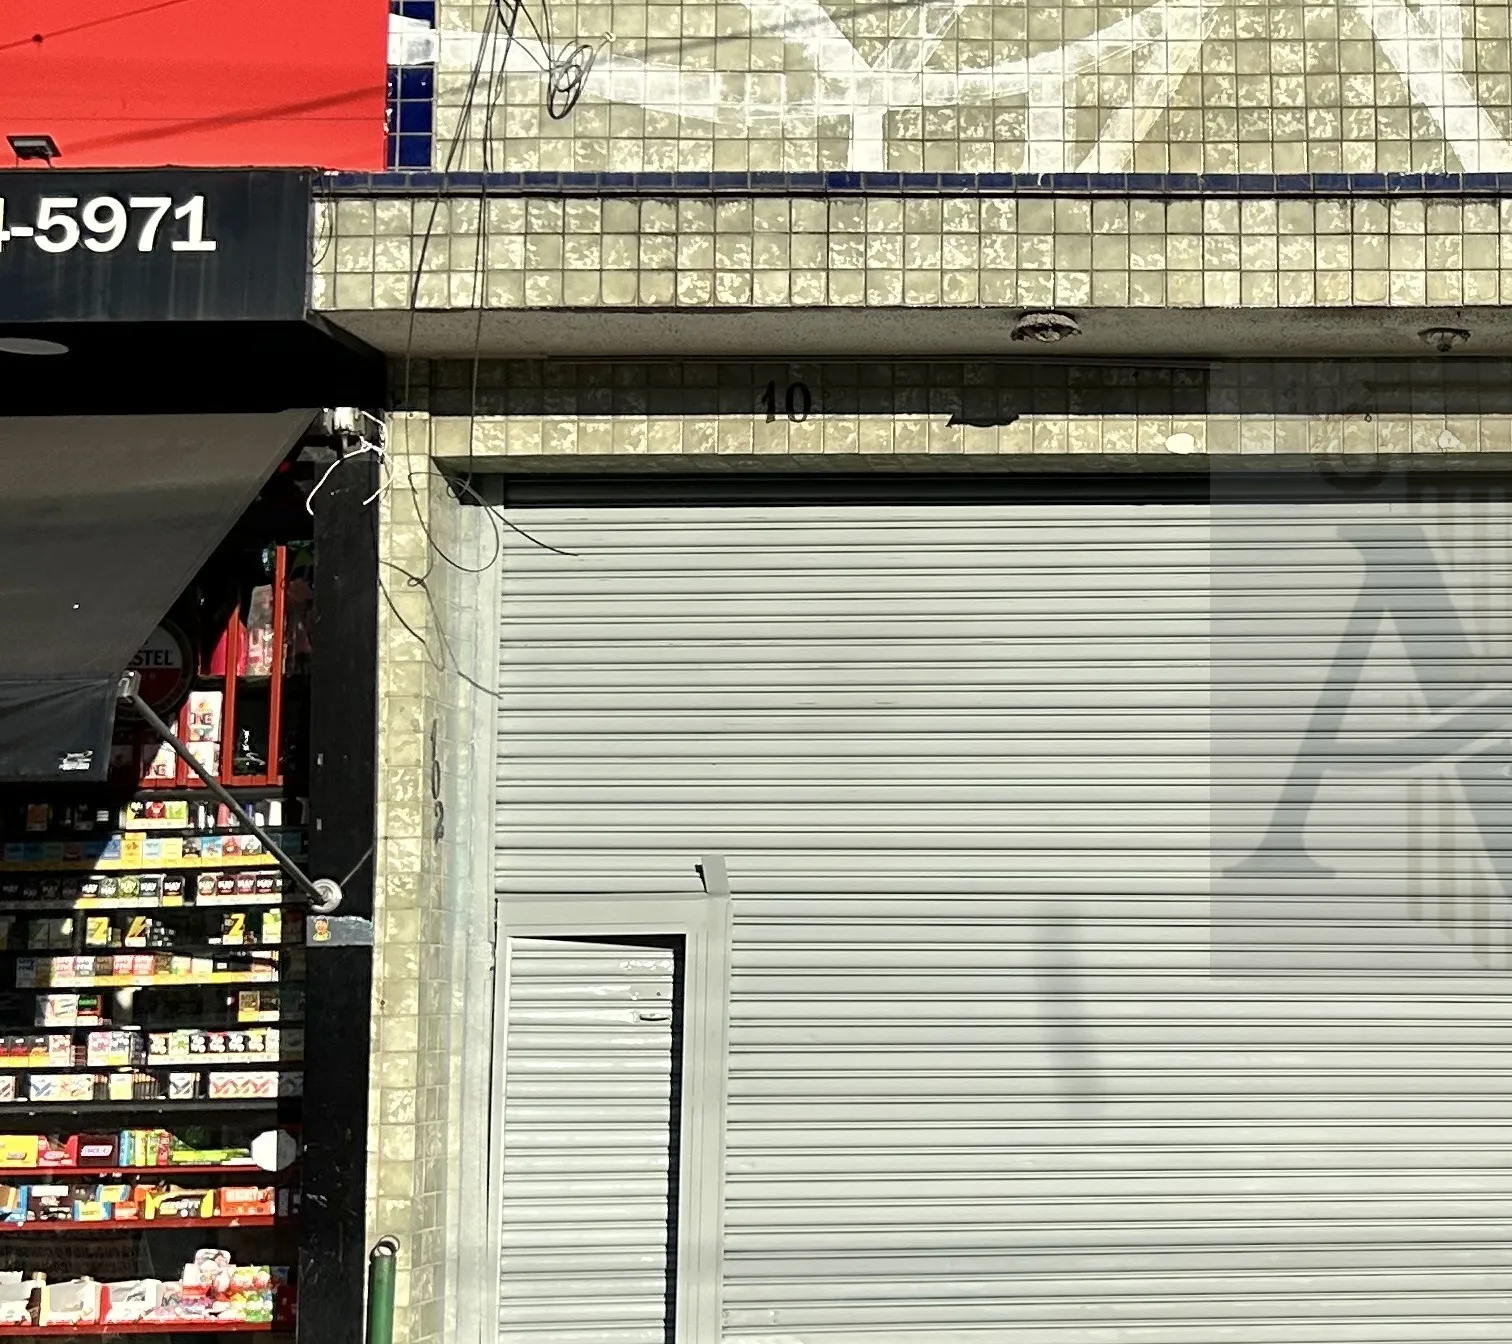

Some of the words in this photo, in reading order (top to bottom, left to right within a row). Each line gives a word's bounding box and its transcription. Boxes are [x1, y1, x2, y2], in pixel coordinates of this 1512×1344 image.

[0, 195, 217, 253] -5971
[761, 380, 812, 424] 10
[128, 649, 173, 666] STEL
